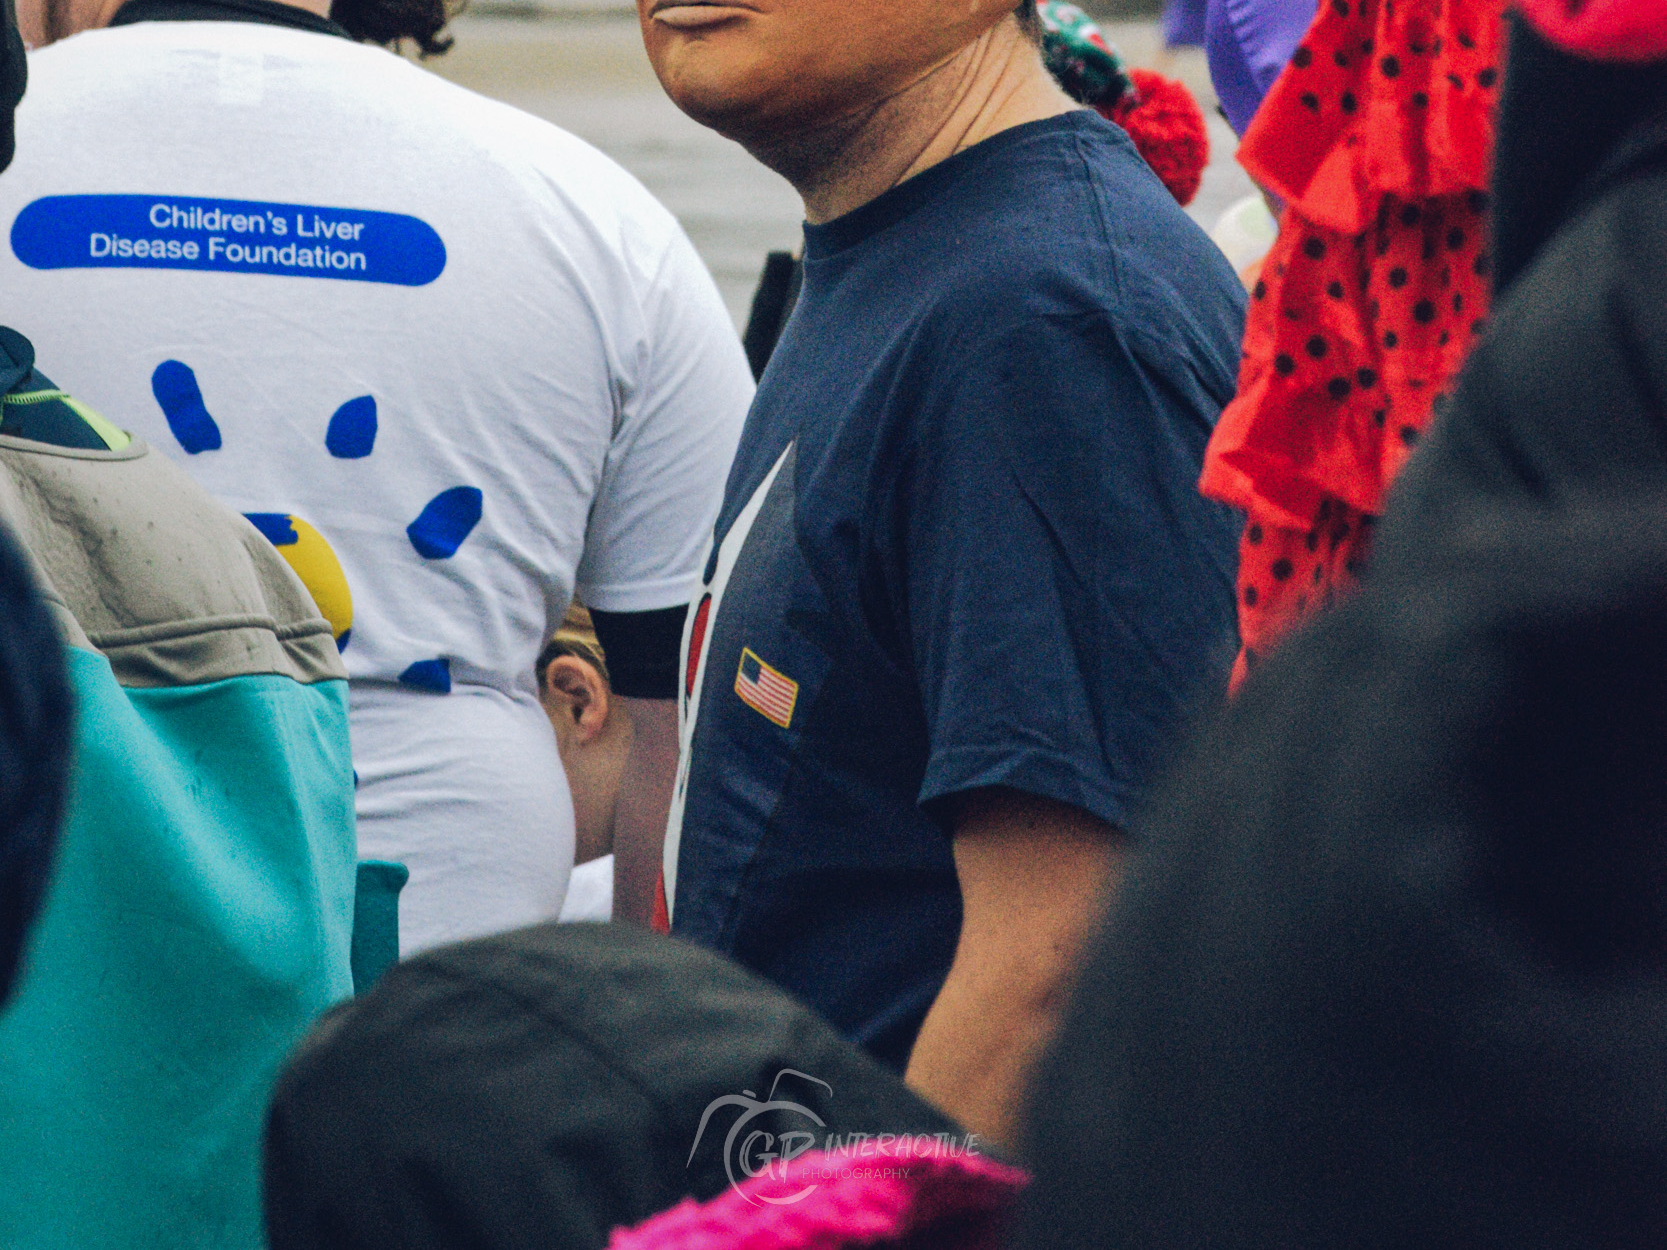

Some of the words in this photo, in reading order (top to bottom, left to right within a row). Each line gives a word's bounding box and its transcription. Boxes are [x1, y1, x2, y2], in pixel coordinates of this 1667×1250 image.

[148, 203, 287, 236] Children's
[296, 214, 365, 241] Liver
[89, 232, 200, 260] Disease
[208, 238, 367, 270] Foundation
